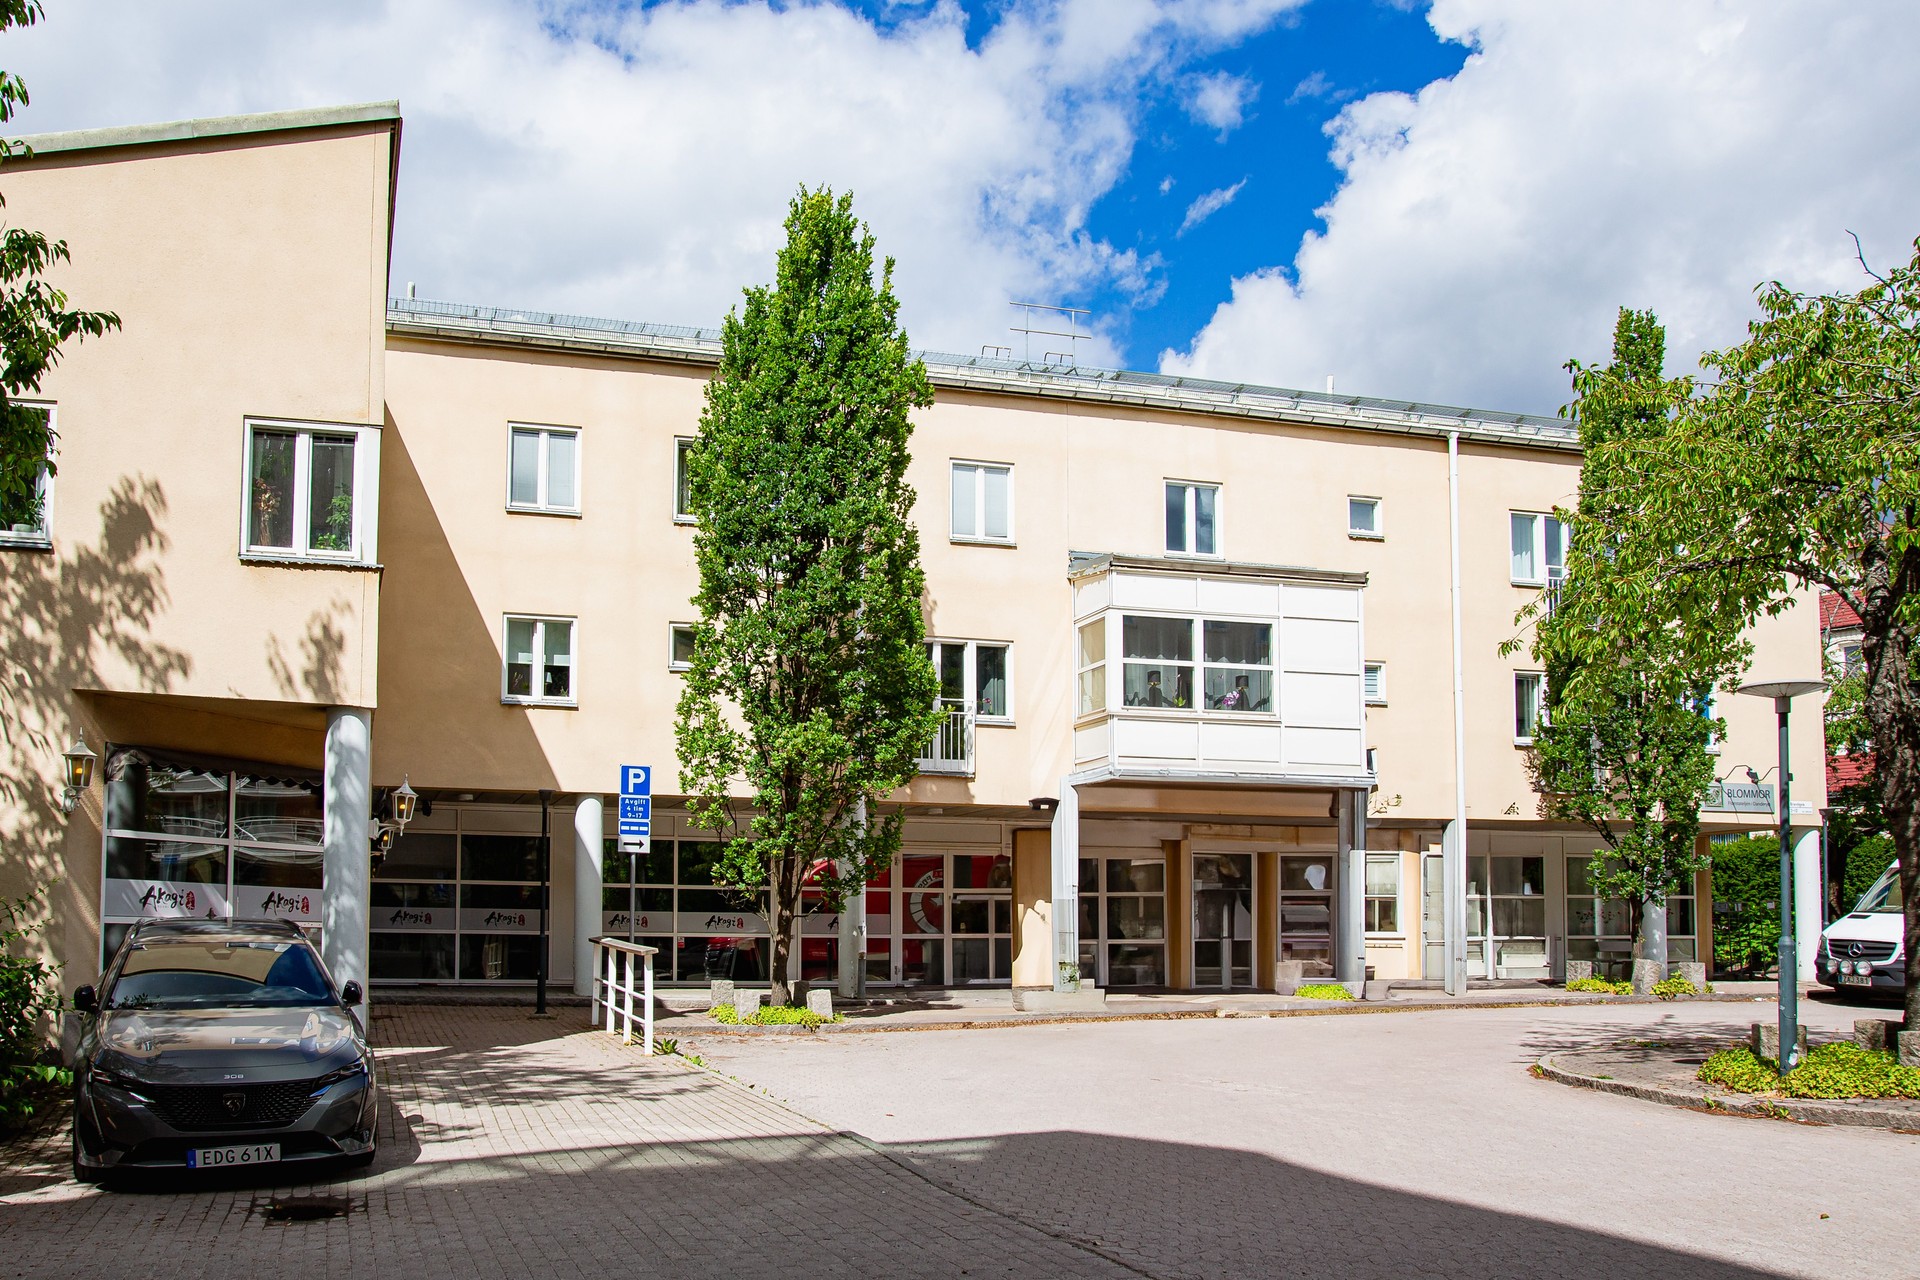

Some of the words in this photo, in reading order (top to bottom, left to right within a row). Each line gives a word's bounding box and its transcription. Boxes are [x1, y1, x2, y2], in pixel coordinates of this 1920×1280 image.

[628, 768, 646, 793] P
[624, 798, 646, 806] Avgift
[1727, 788, 1771, 799] BLOMMOR
[139, 884, 184, 912] Akagi
[261, 890, 301, 916] Akagi
[390, 909, 424, 926] Akagi
[484, 911, 517, 927] Akagi
[608, 913, 640, 930] Akai
[705, 915, 736, 930] Akagi
[203, 1149, 235, 1165] EDG
[240, 1145, 273, 1162] 61X
